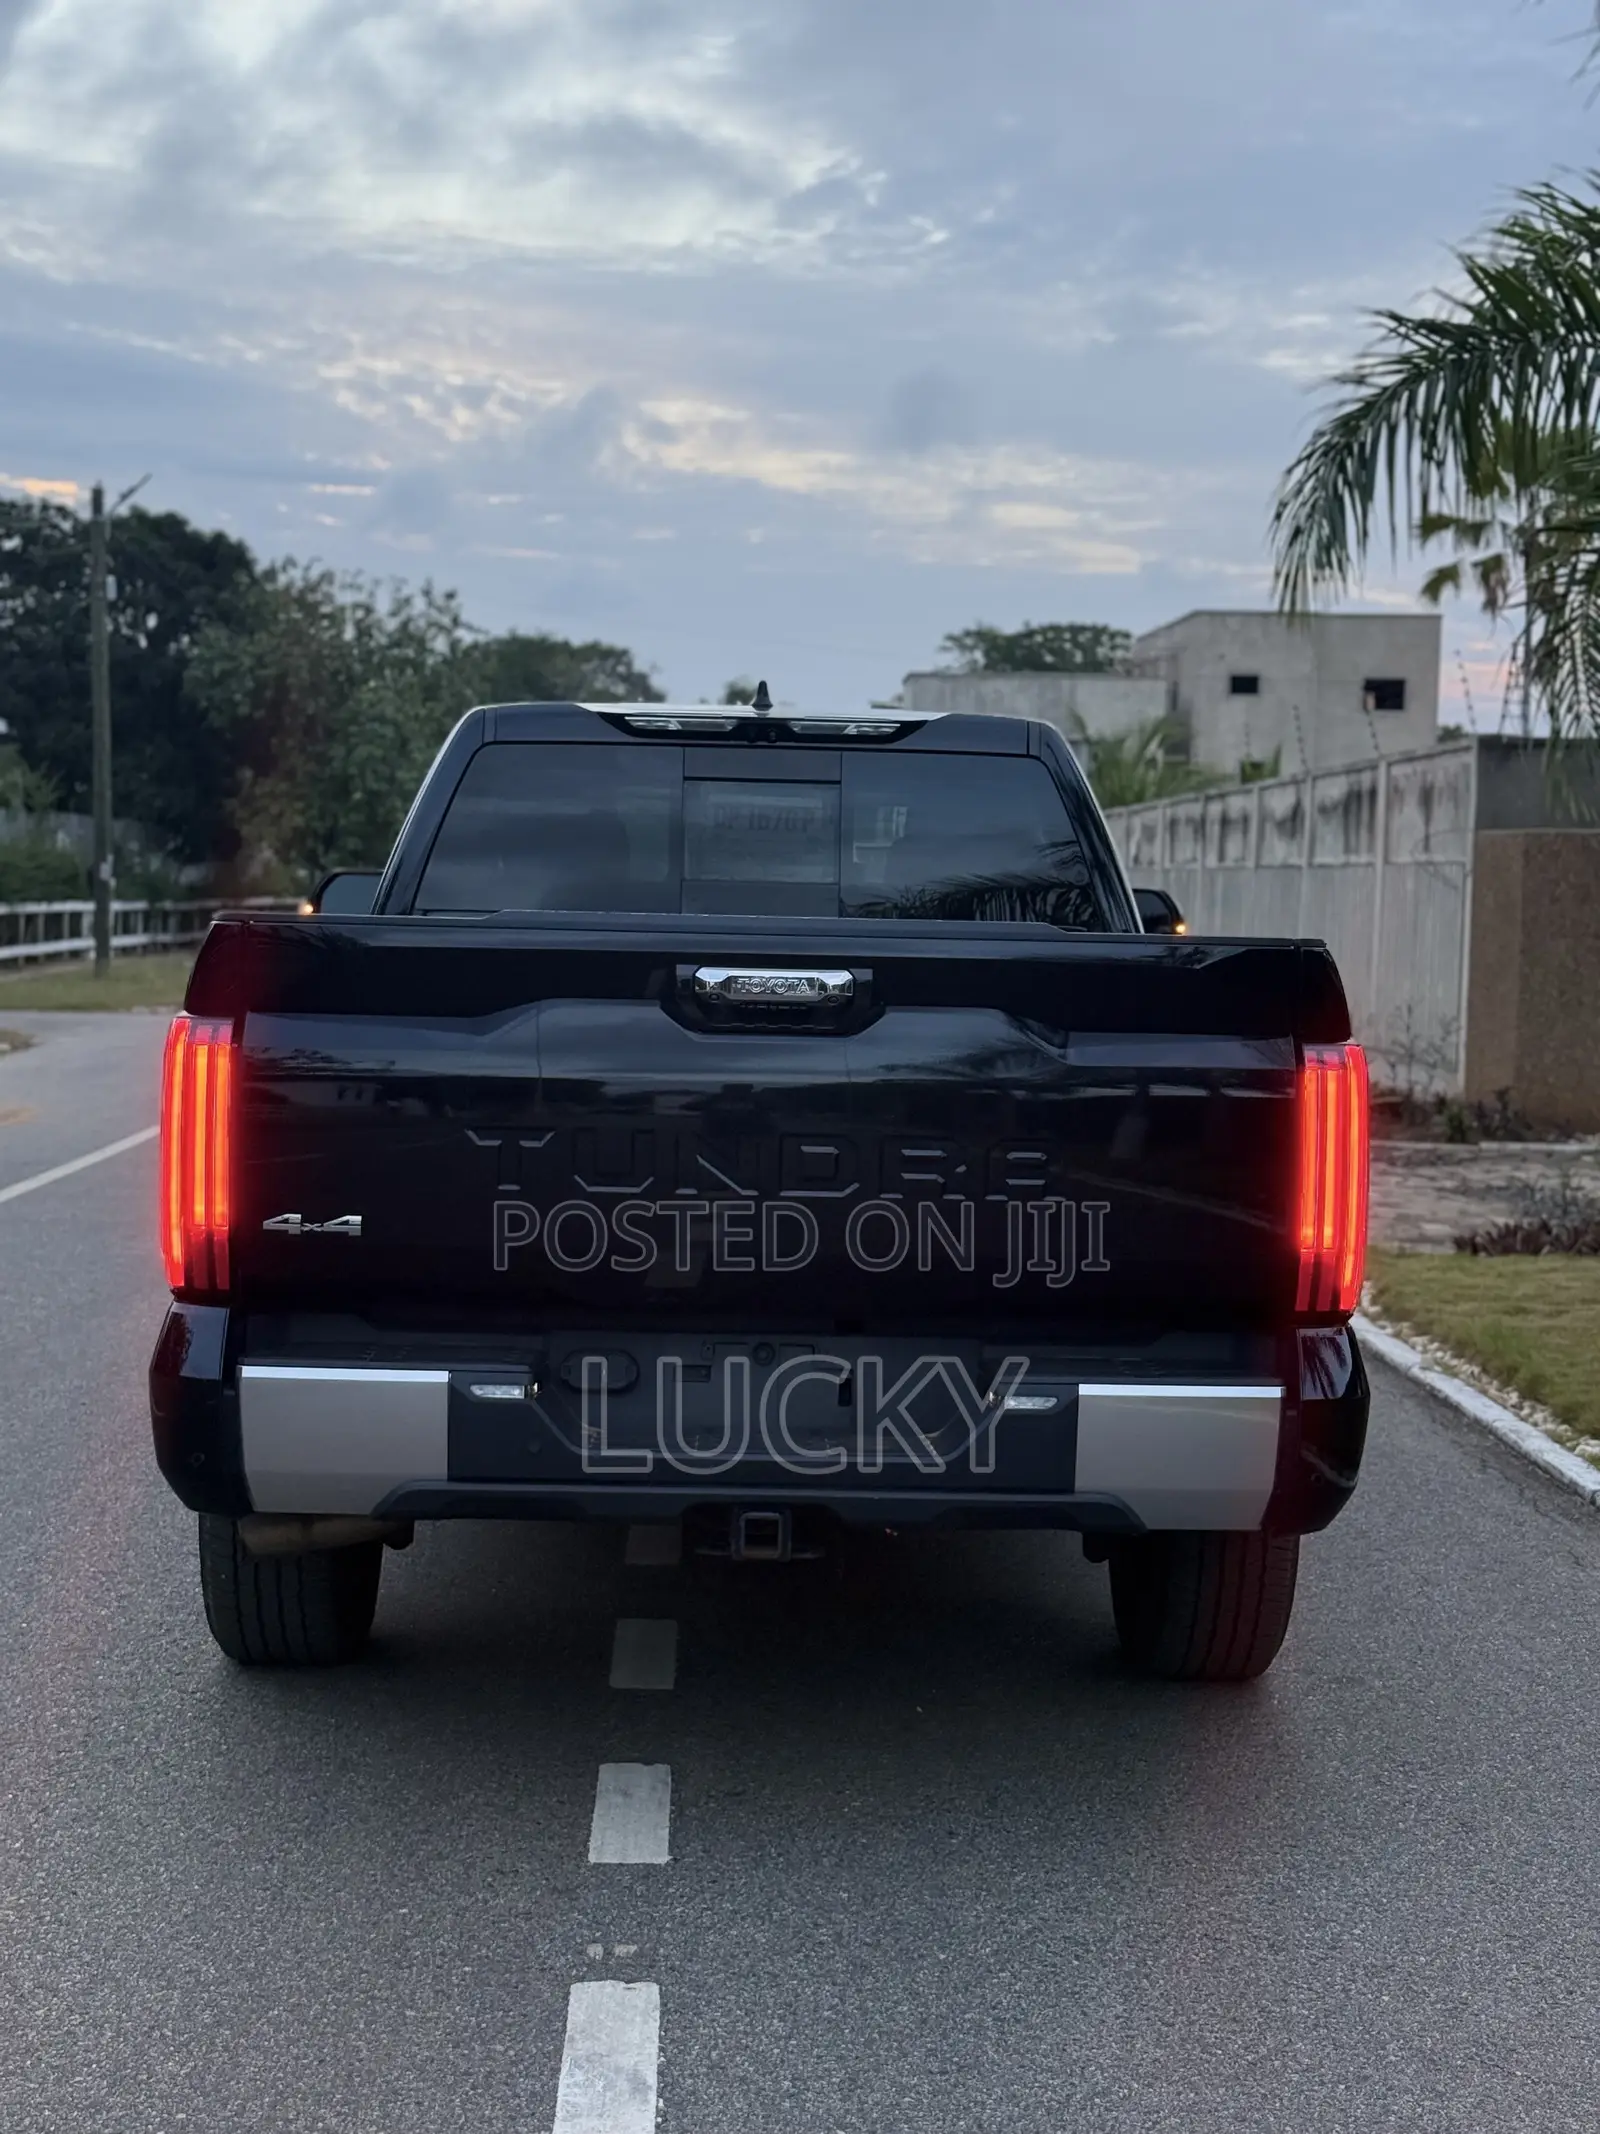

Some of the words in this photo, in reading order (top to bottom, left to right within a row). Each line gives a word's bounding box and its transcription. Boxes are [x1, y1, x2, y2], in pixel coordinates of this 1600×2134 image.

[736, 977, 812, 995] TOYOTA
[463, 1126, 1068, 1202] TUNDRA
[262, 1212, 363, 1237] 4x4
